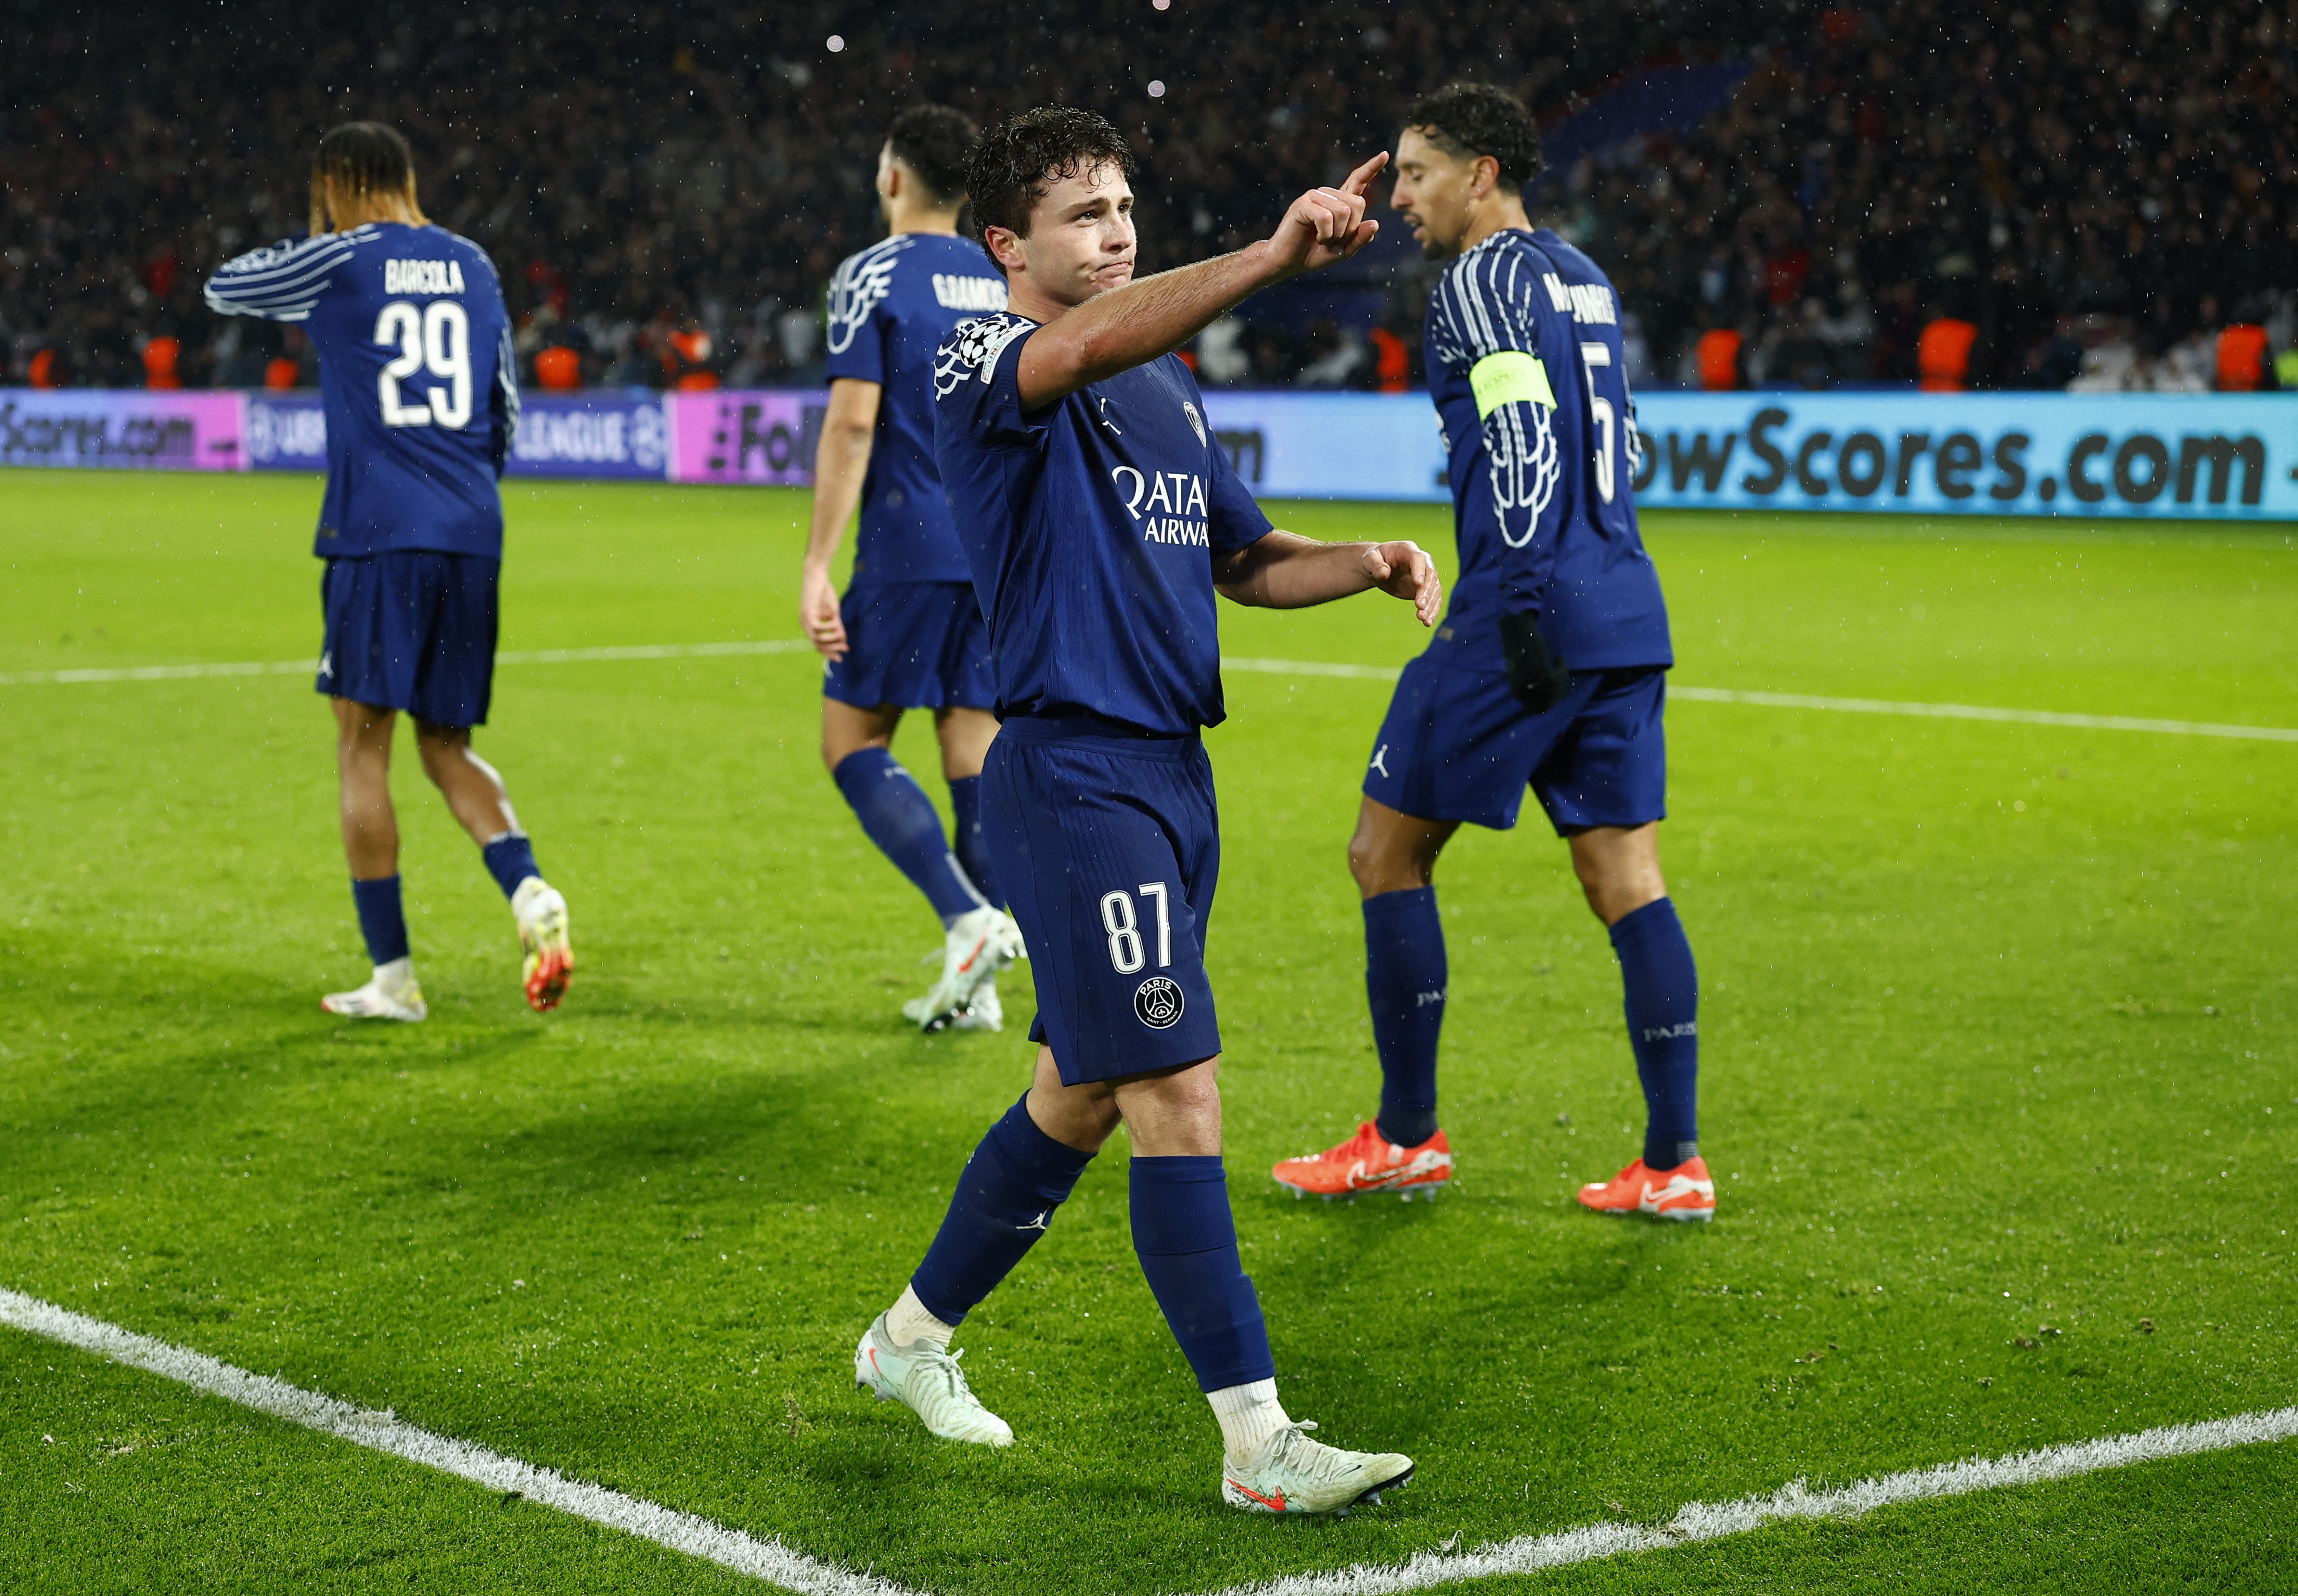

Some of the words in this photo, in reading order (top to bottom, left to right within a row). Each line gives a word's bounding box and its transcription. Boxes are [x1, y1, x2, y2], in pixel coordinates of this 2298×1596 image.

[384, 258, 465, 295] BARCOLA
[373, 299, 473, 431] 29
[1580, 341, 1616, 505] 5
[1112, 466, 1208, 521] QATA
[1144, 516, 1210, 548] AIRWA
[1100, 882, 1171, 975] 87
[1139, 979, 1172, 996] PARIS
